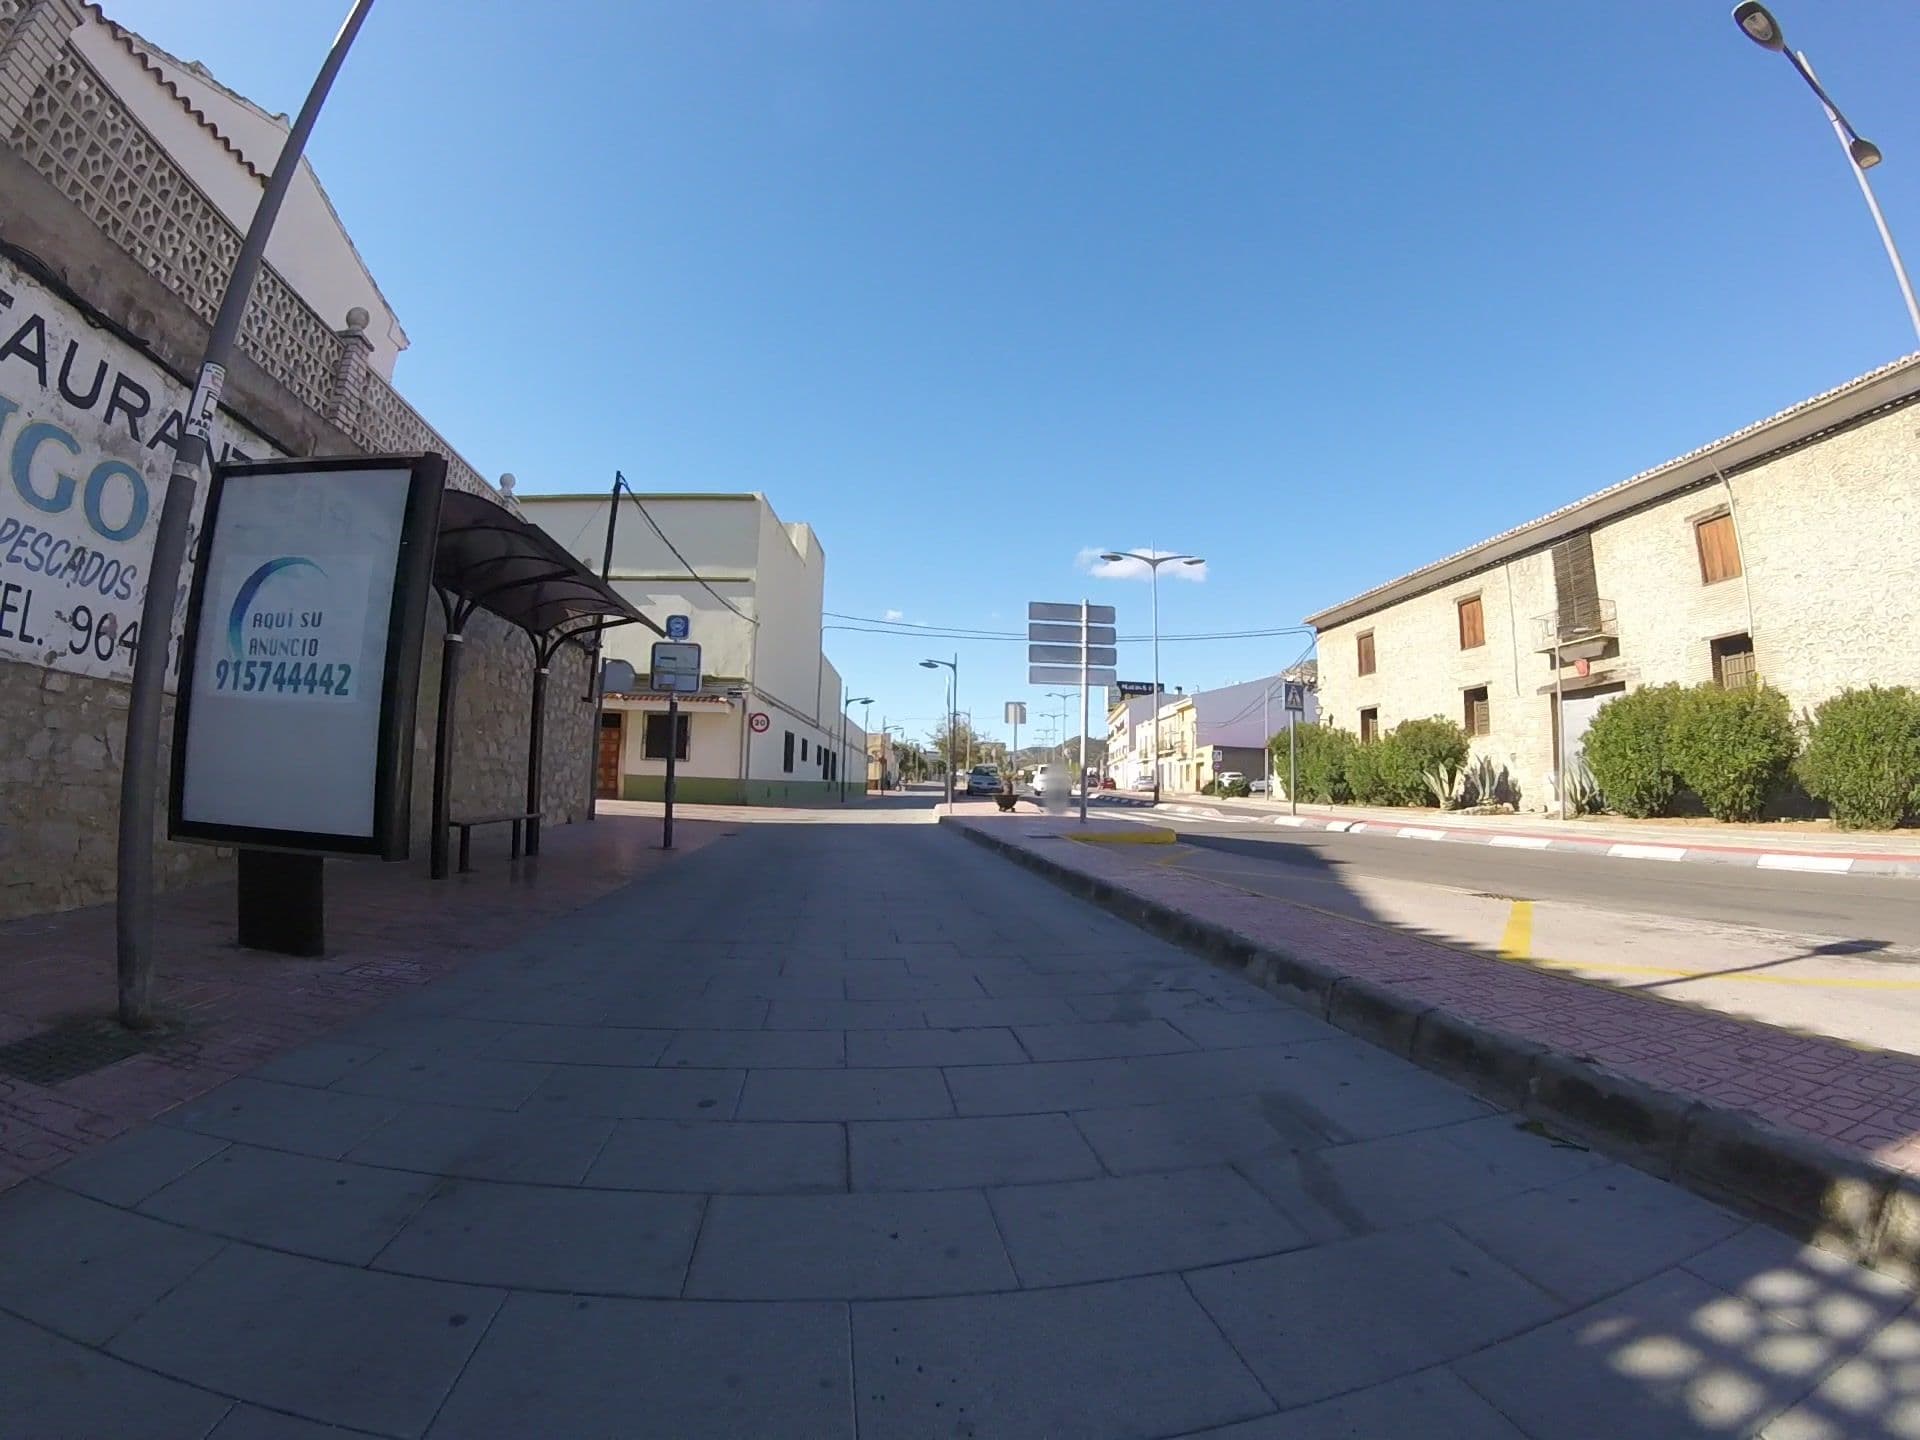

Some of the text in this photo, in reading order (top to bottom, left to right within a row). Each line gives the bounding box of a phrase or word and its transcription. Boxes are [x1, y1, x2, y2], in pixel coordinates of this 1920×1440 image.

[0, 580, 43, 646] EL.
[300, 611, 323, 628] SU
[249, 637, 319, 657] ANUNCIO
[216, 658, 352, 696] 915744442
